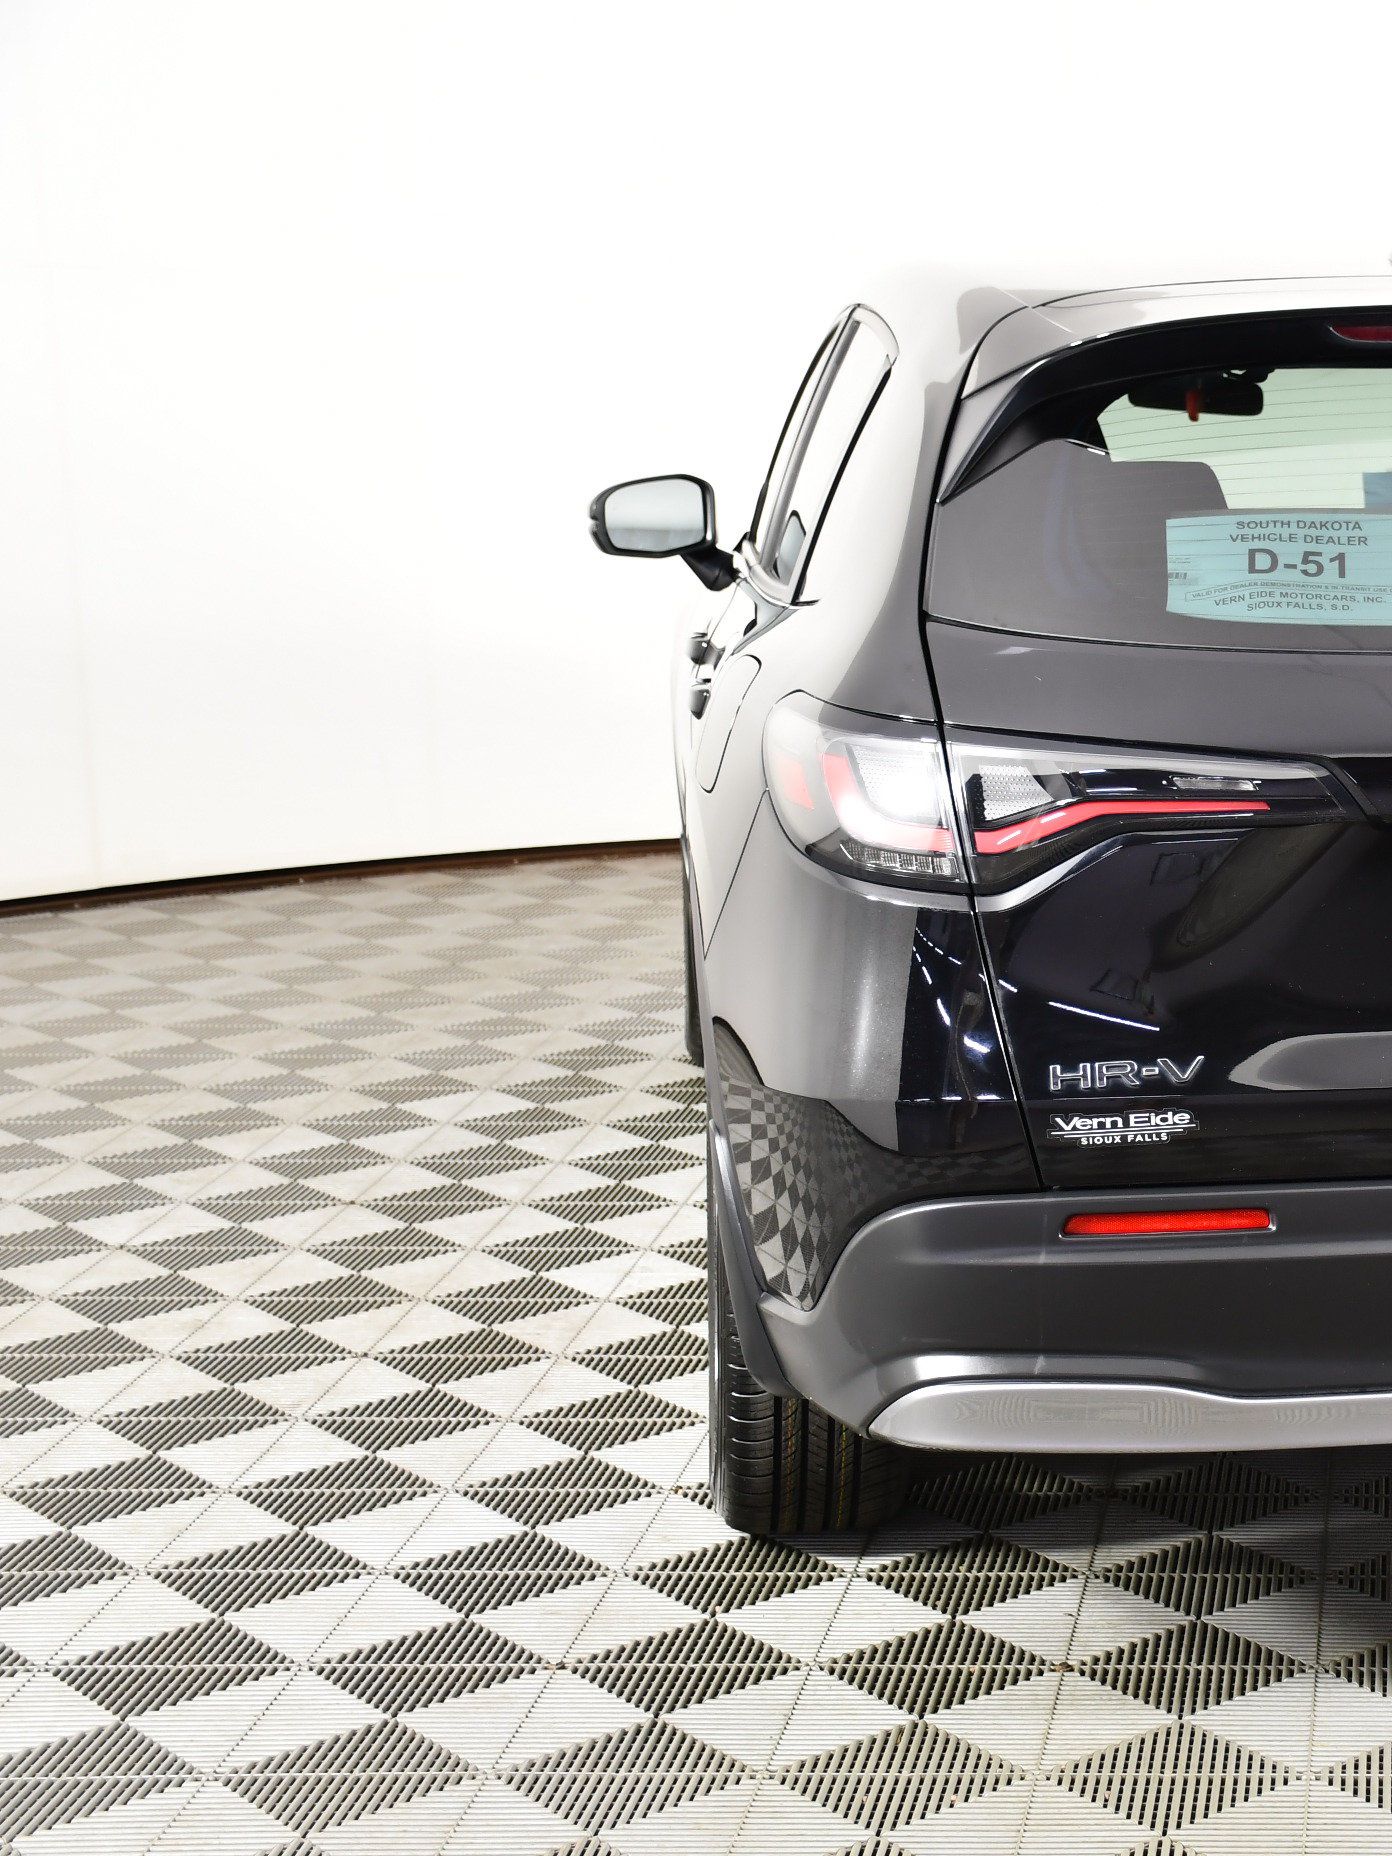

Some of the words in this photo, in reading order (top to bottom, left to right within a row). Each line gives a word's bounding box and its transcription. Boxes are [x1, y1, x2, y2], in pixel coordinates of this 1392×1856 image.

[1236, 520, 1291, 530] SOUTH
[1297, 520, 1363, 531] DAKOTA
[1229, 533, 1298, 543] VEHICLE
[1304, 535, 1368, 546] DEALER
[1248, 548, 1346, 579] D-51
[1192, 590, 1213, 599] VALID
[1230, 582, 1259, 591] DEALER
[1214, 594, 1246, 606] VERN
[1249, 590, 1276, 600] EIDE
[1280, 592, 1360, 604] MOTORCARS,
[1247, 601, 1283, 612] SIOUX
[1286, 602, 1326, 611] FALLS,
[1050, 1055, 1205, 1091] HR-V
[1055, 1116, 1123, 1131] Vern
[1129, 1111, 1191, 1127] Eide
[1081, 1135, 1121, 1145] SIOUX
[1128, 1132, 1168, 1143] FALLS
